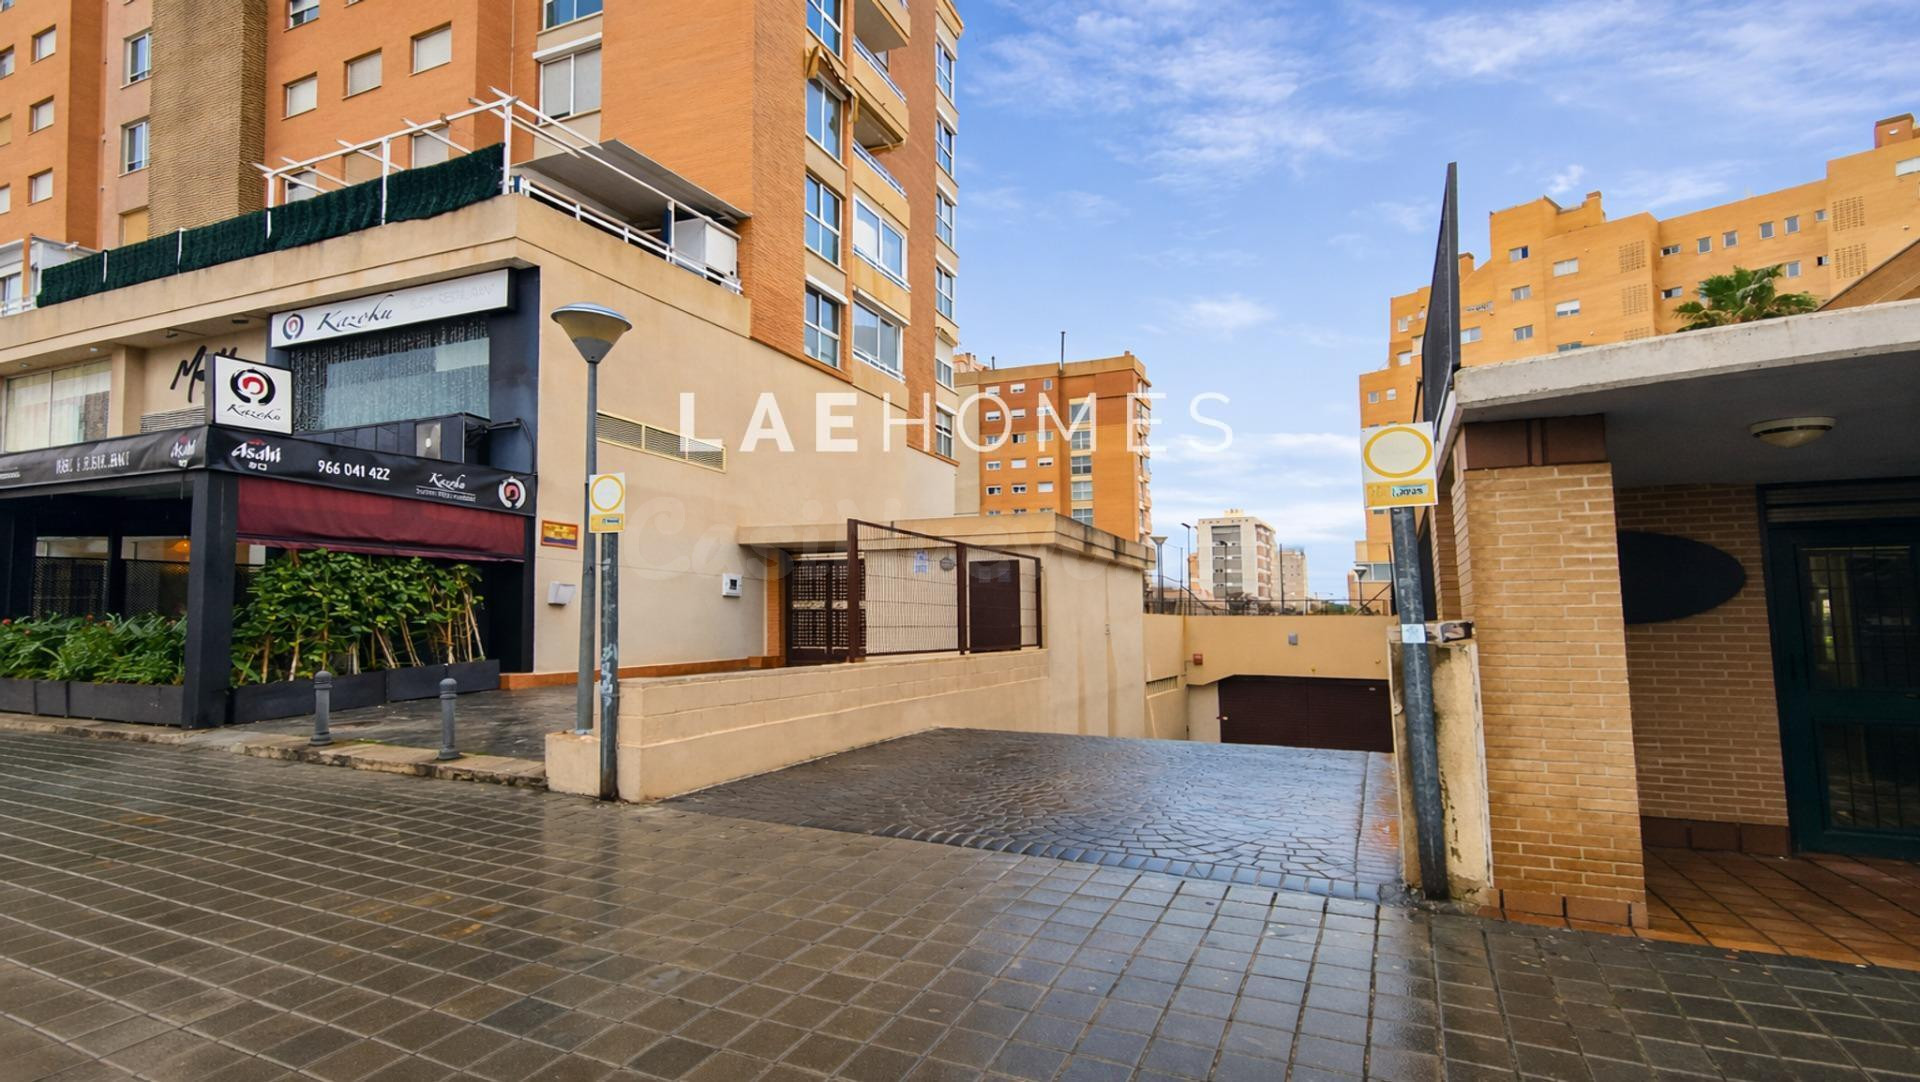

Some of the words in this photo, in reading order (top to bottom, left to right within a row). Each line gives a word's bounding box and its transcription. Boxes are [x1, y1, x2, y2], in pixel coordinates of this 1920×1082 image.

[231, 442, 281, 463] Asahi
[318, 459, 341, 475] 966
[344, 463, 365, 478] 041
[368, 466, 391, 481] 422
